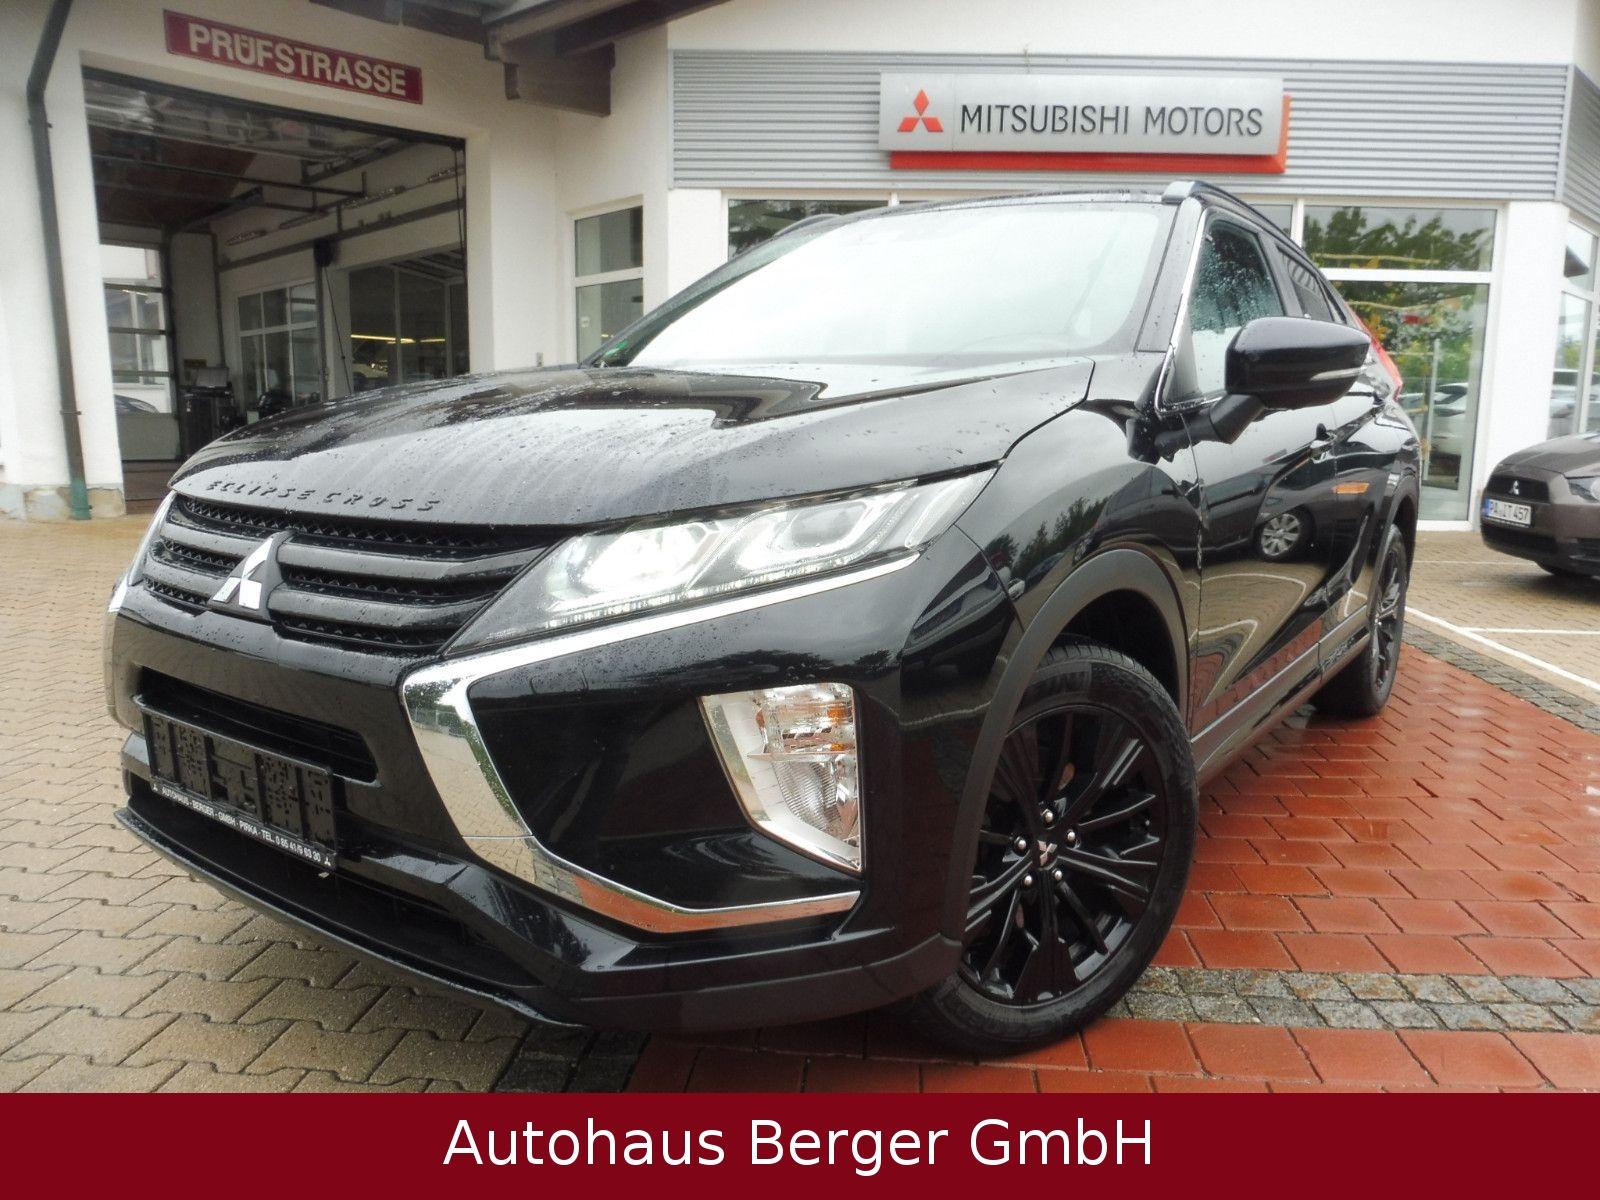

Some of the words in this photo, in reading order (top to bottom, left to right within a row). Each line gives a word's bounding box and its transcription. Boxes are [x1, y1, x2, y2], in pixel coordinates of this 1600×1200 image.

[188, 22, 406, 97] PRÜFSTRASSE
[961, 104, 1128, 134] MITSUBISHI
[1143, 106, 1263, 136] MOTORS
[206, 480, 316, 500] ECLIPSE
[323, 493, 441, 512] CROSS
[162, 786, 189, 806] AUTOHAUS
[192, 799, 214, 818] BERGER
